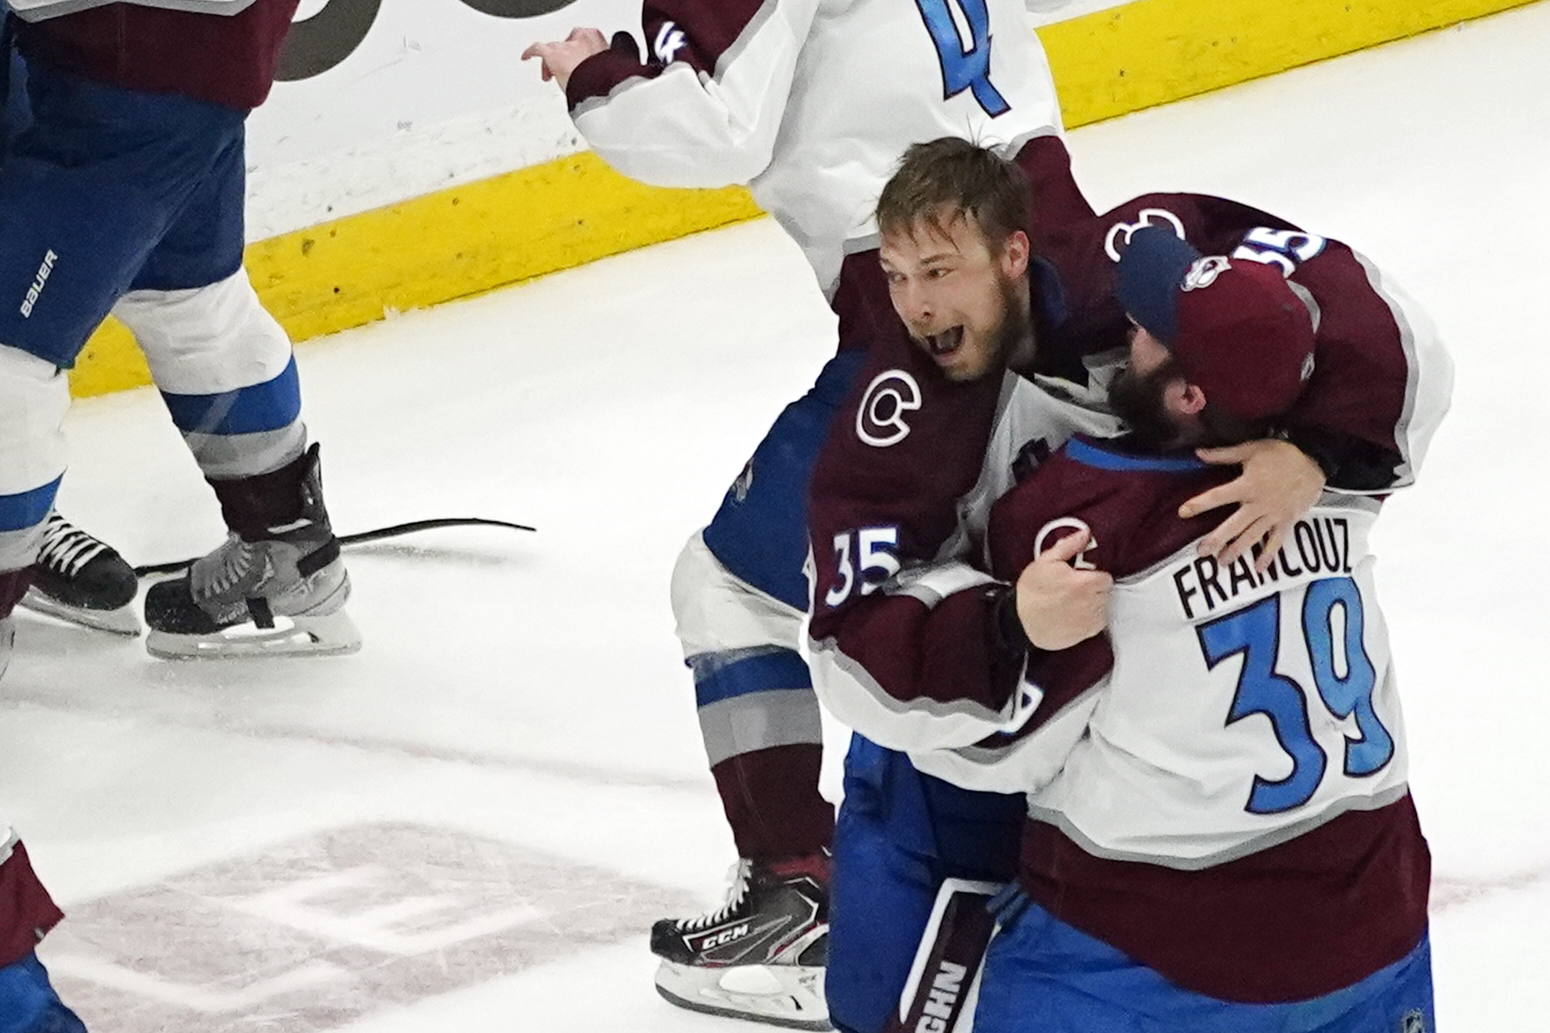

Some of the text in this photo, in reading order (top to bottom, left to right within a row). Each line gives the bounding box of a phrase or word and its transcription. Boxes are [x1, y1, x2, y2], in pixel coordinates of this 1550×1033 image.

[19, 248, 59, 319] BAUER
[824, 524, 901, 608] 35
[1194, 576, 1395, 815] 39
[701, 923, 749, 951] CCM
